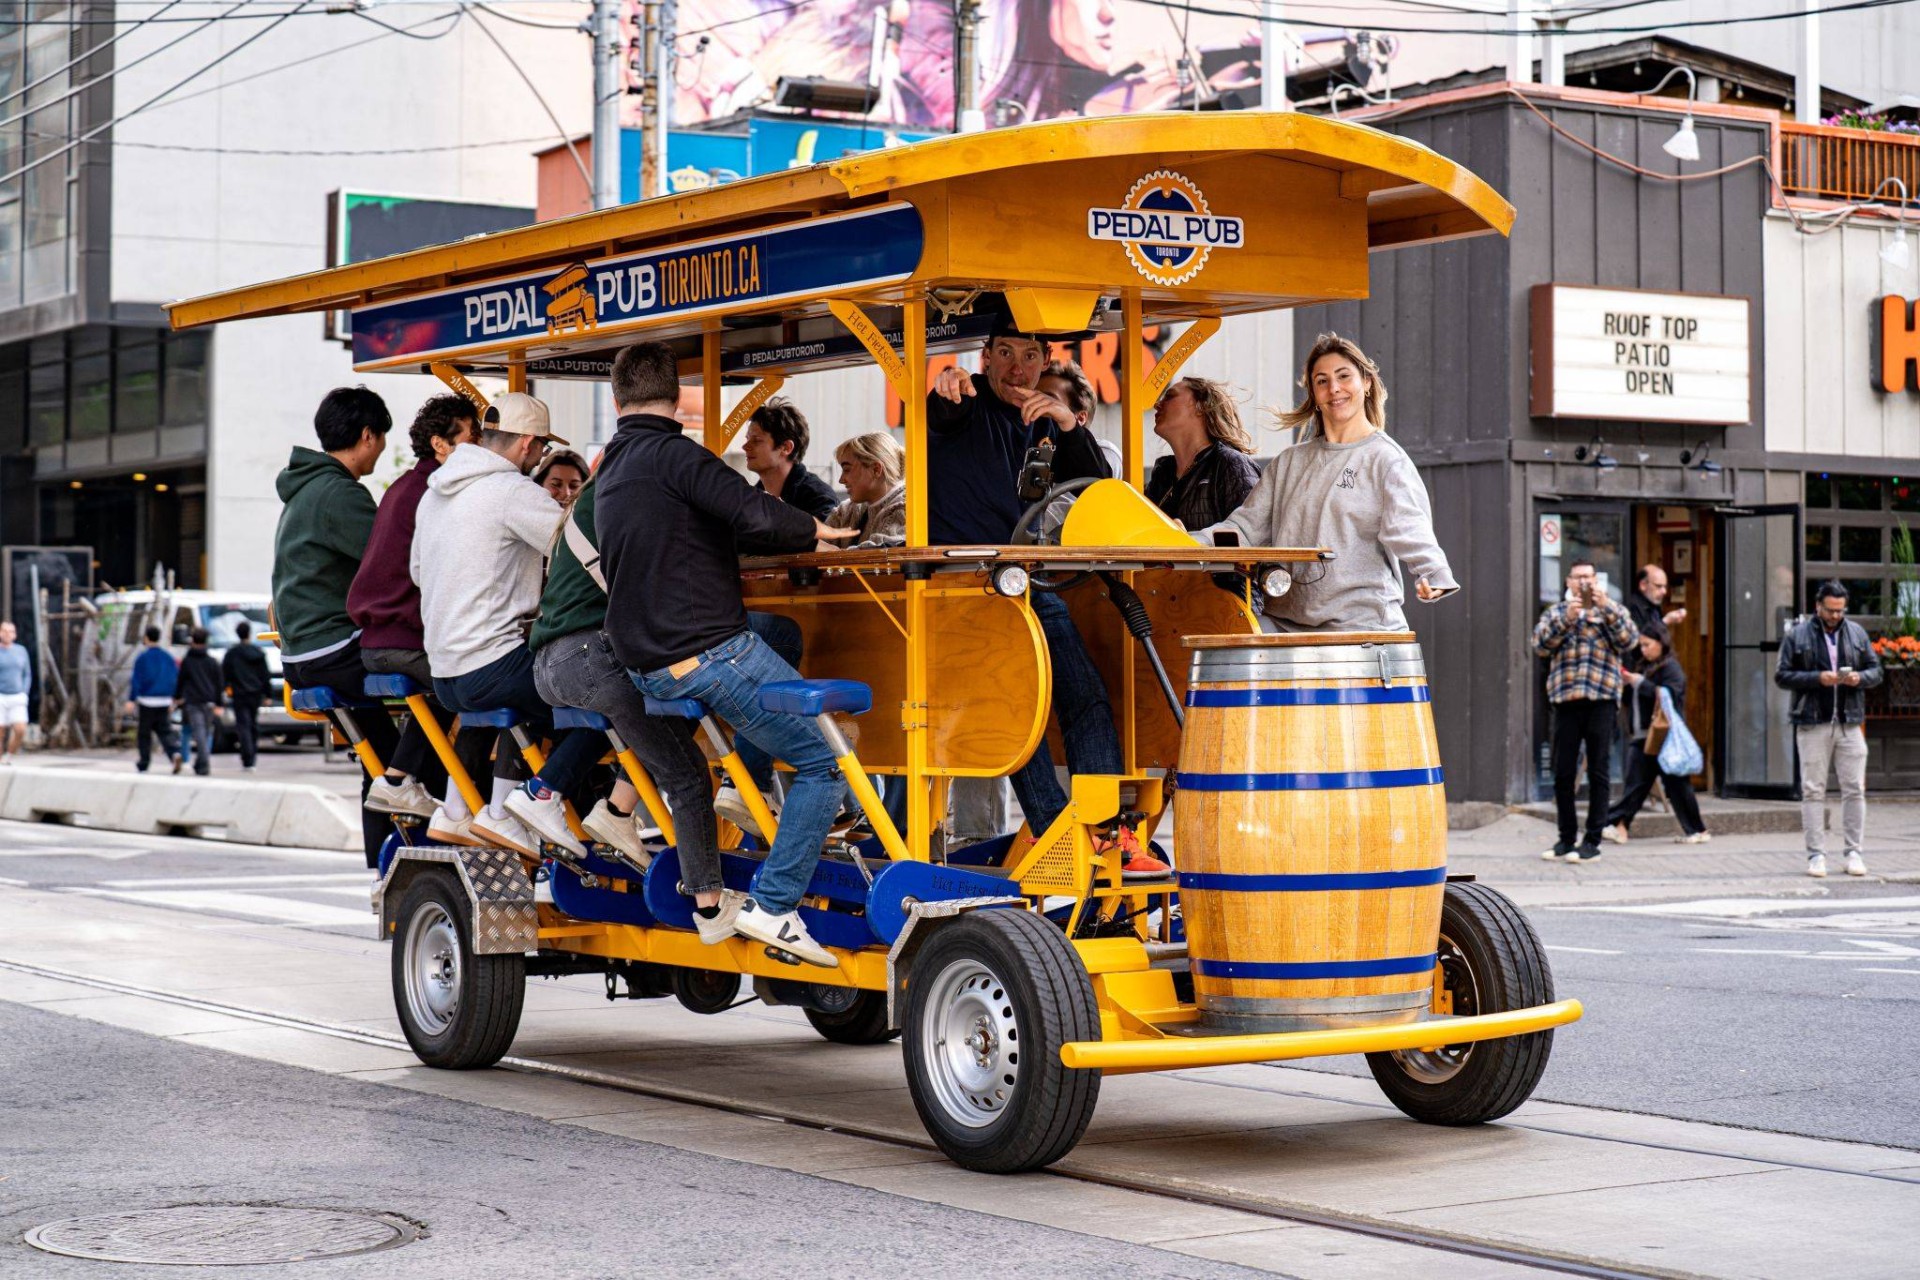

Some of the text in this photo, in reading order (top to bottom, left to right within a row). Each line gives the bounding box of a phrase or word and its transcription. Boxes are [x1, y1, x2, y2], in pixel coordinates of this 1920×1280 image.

[1092, 211, 1240, 244] PEDAL PUB
[1156, 247, 1180, 258] TORONTO
[464, 244, 761, 338] PEDAL PUB TORONTO.CA
[1662, 316, 1698, 340] TOP
[751, 343, 825, 364] PEDALPUBTORONTO
[1626, 370, 1674, 395] OPEN
